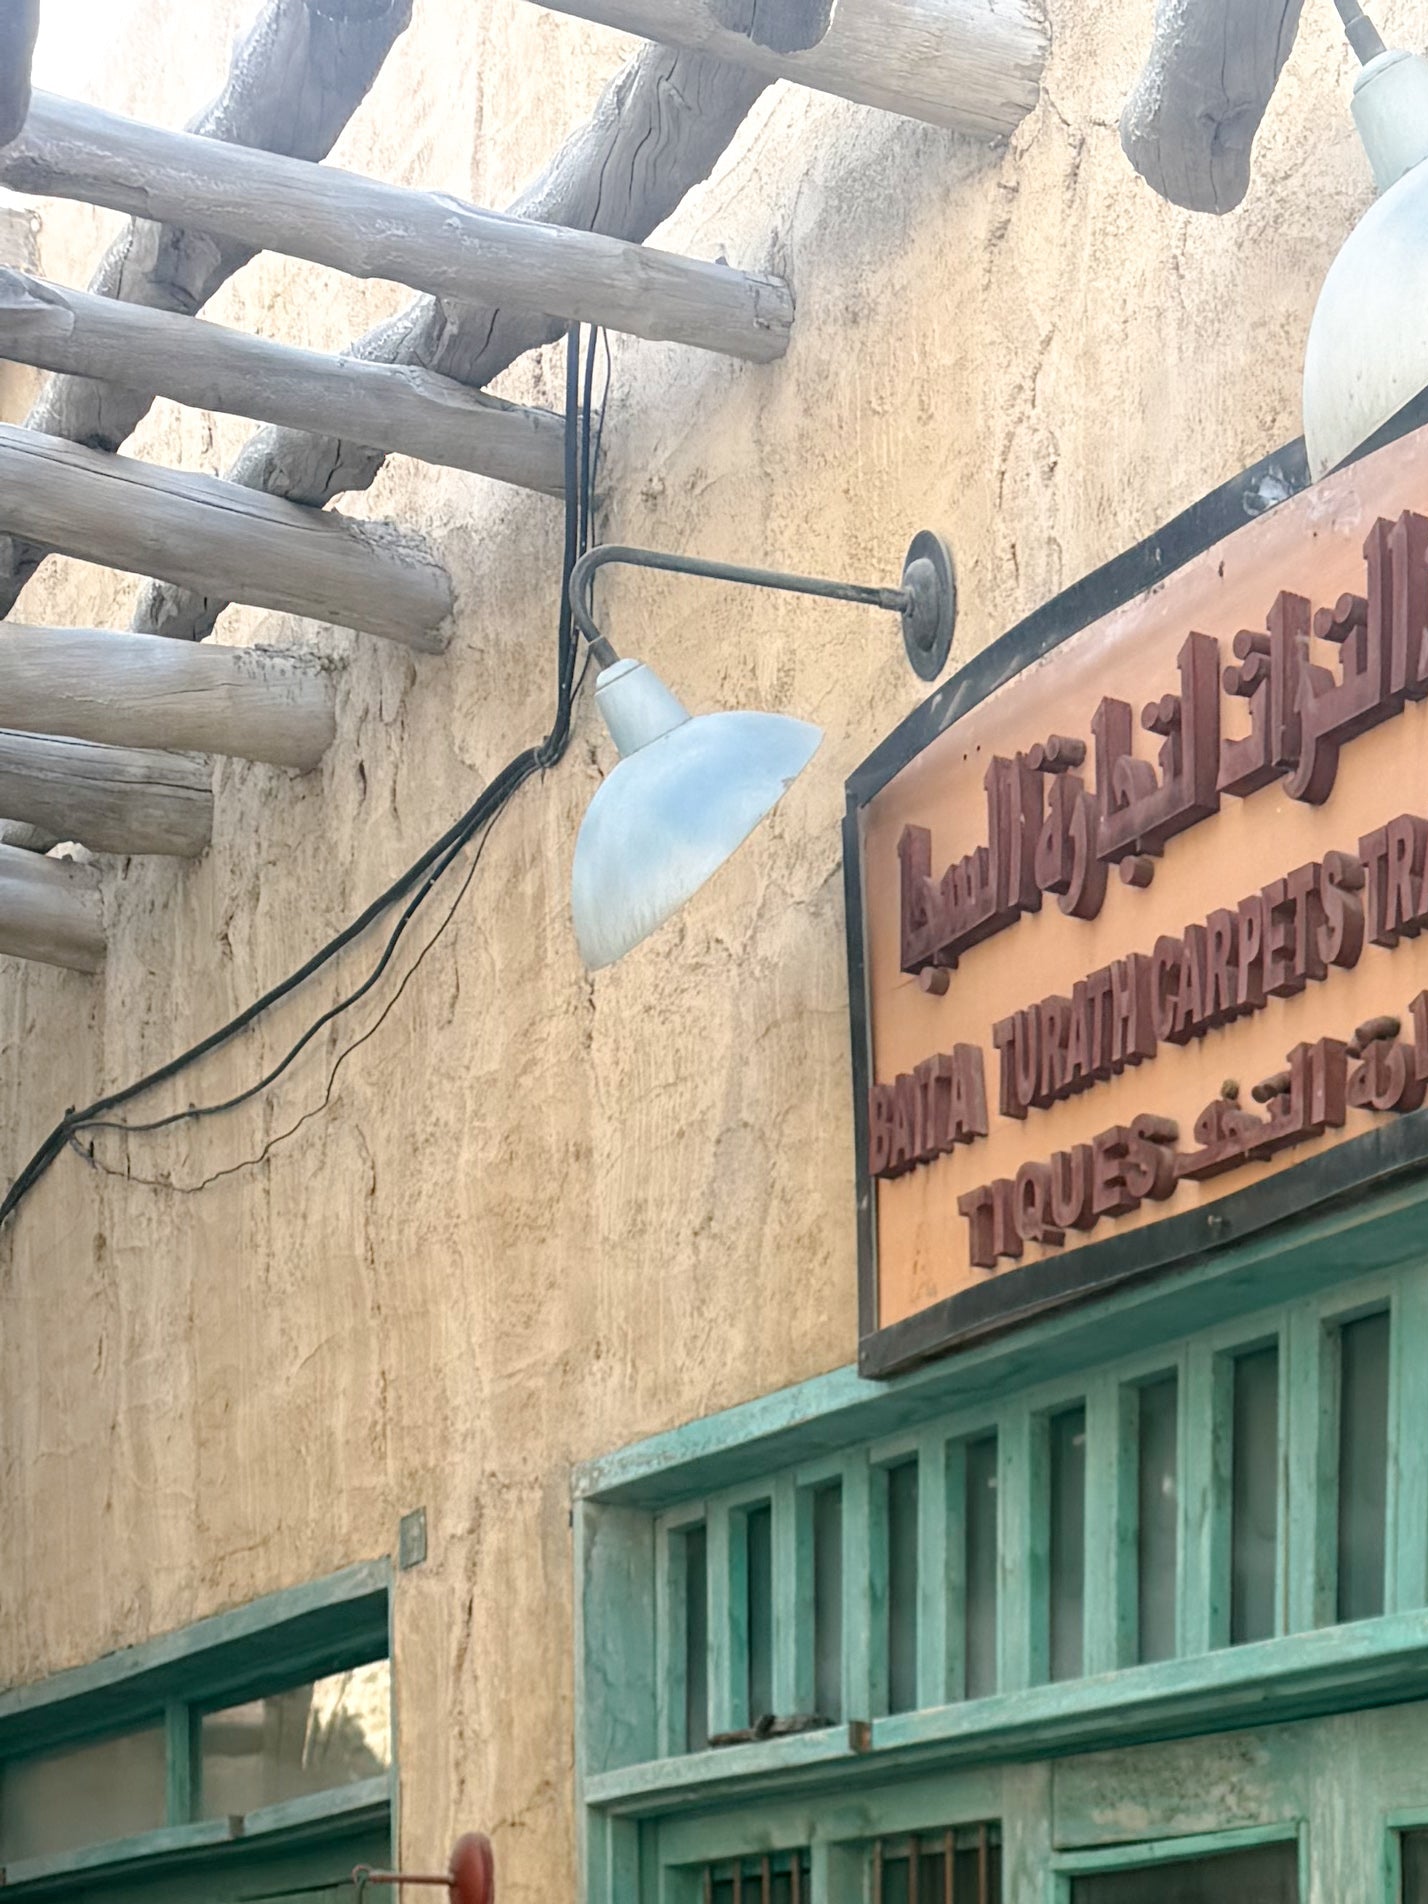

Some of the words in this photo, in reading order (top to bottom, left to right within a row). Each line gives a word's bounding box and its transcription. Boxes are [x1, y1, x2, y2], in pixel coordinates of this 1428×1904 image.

[992, 953, 1157, 1121] TURATH
[1151, 850, 1365, 1046] CARPETS
[957, 1113, 1179, 1268] TIQUES
